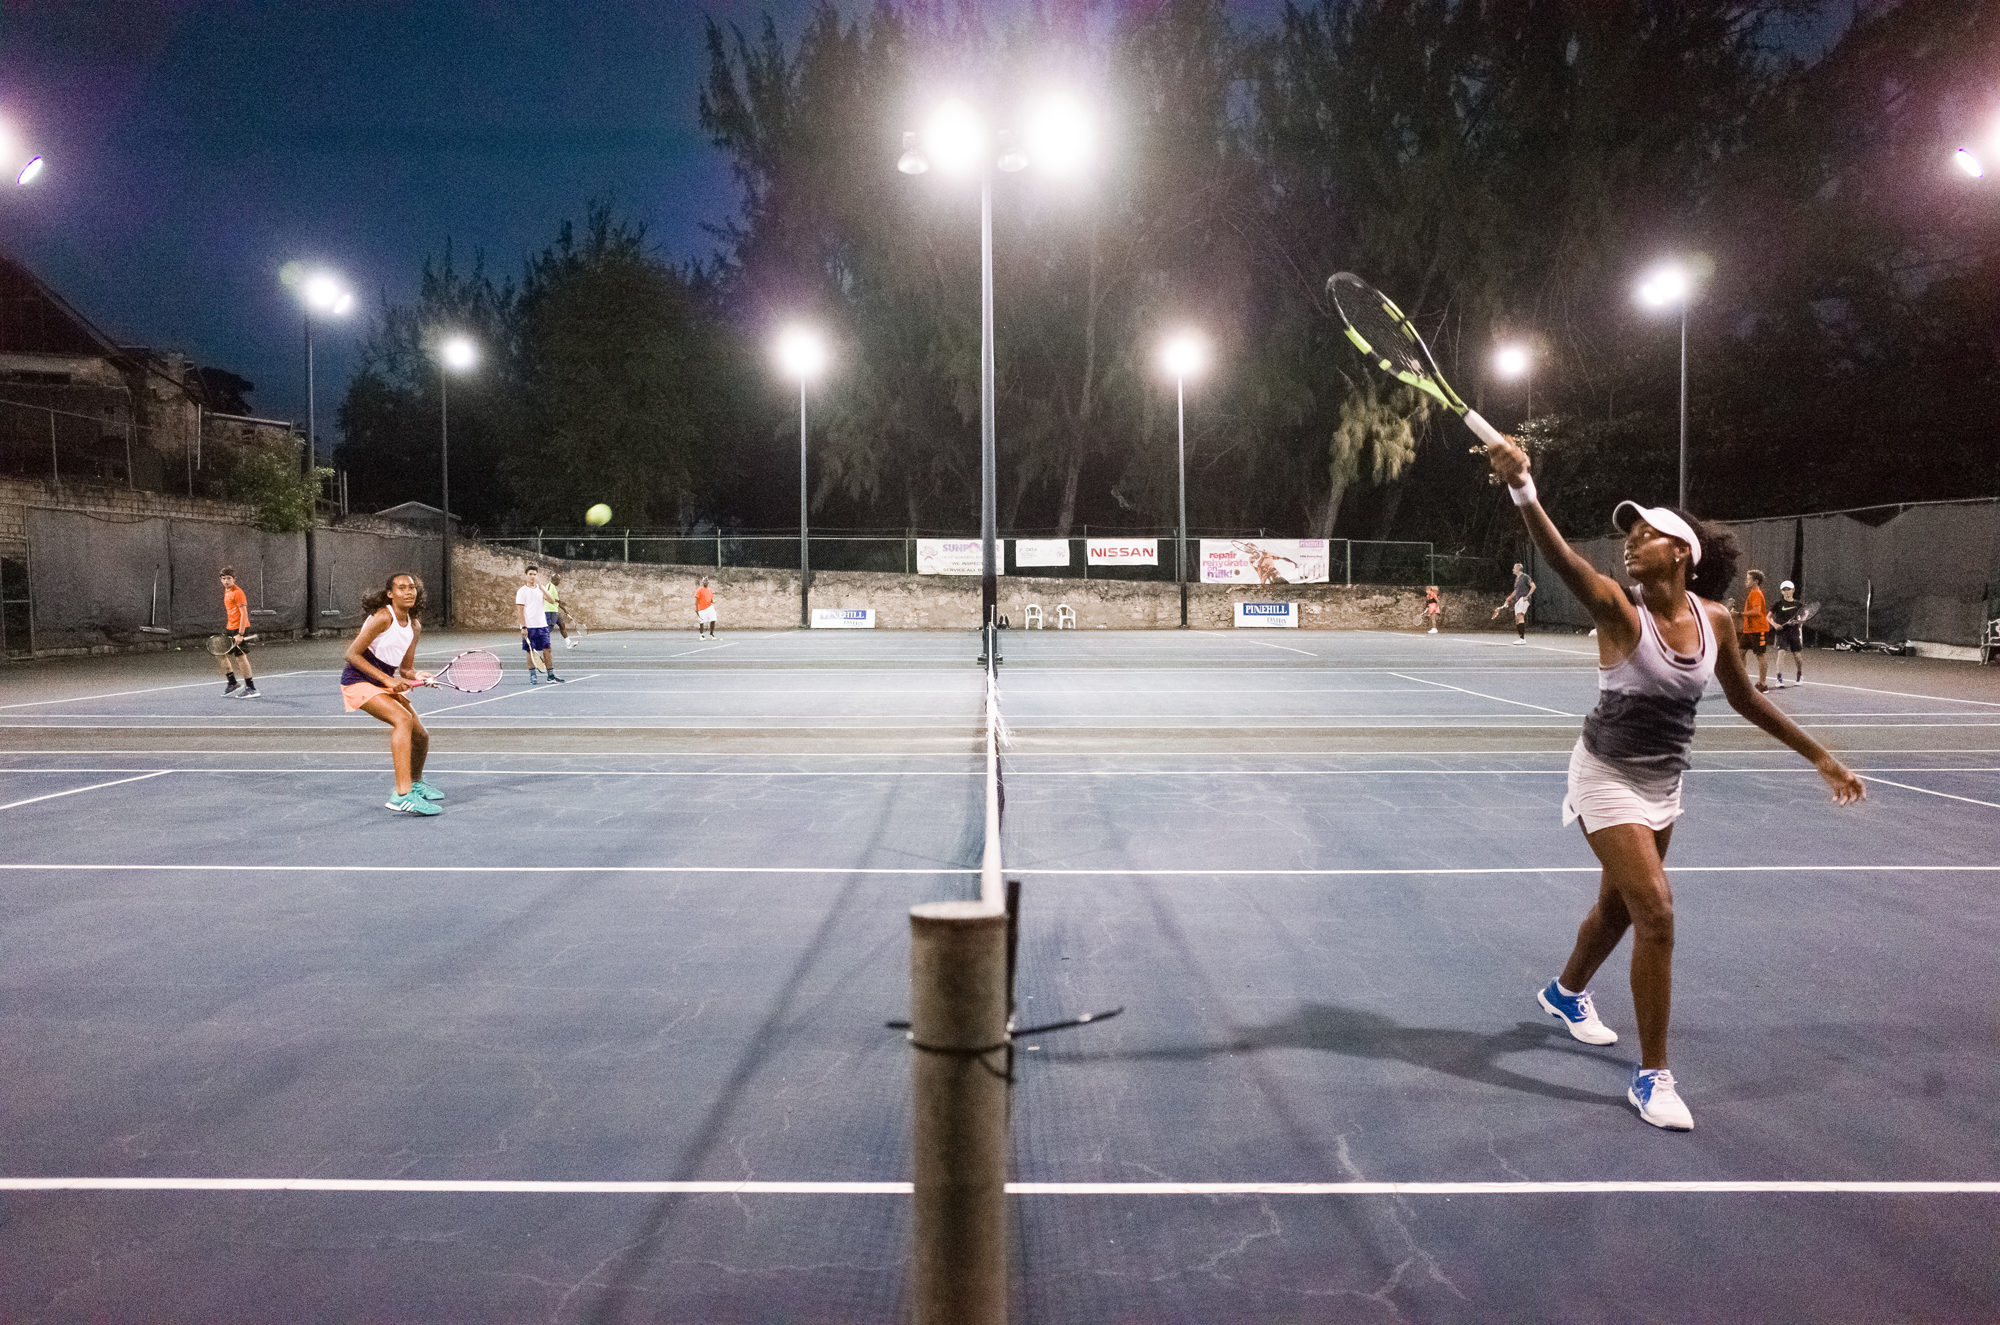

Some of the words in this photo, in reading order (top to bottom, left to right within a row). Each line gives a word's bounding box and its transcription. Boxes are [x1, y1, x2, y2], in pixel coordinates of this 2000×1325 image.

[1091, 547, 1154, 557] NISSAN
[1209, 551, 1237, 560] repair
[1202, 559, 1249, 568] rehydrate
[1207, 569, 1233, 579] milk!
[1245, 604, 1288, 614] PINEHILL
[821, 610, 865, 619] PINEHILL
[1267, 617, 1287, 625] DAIRY
